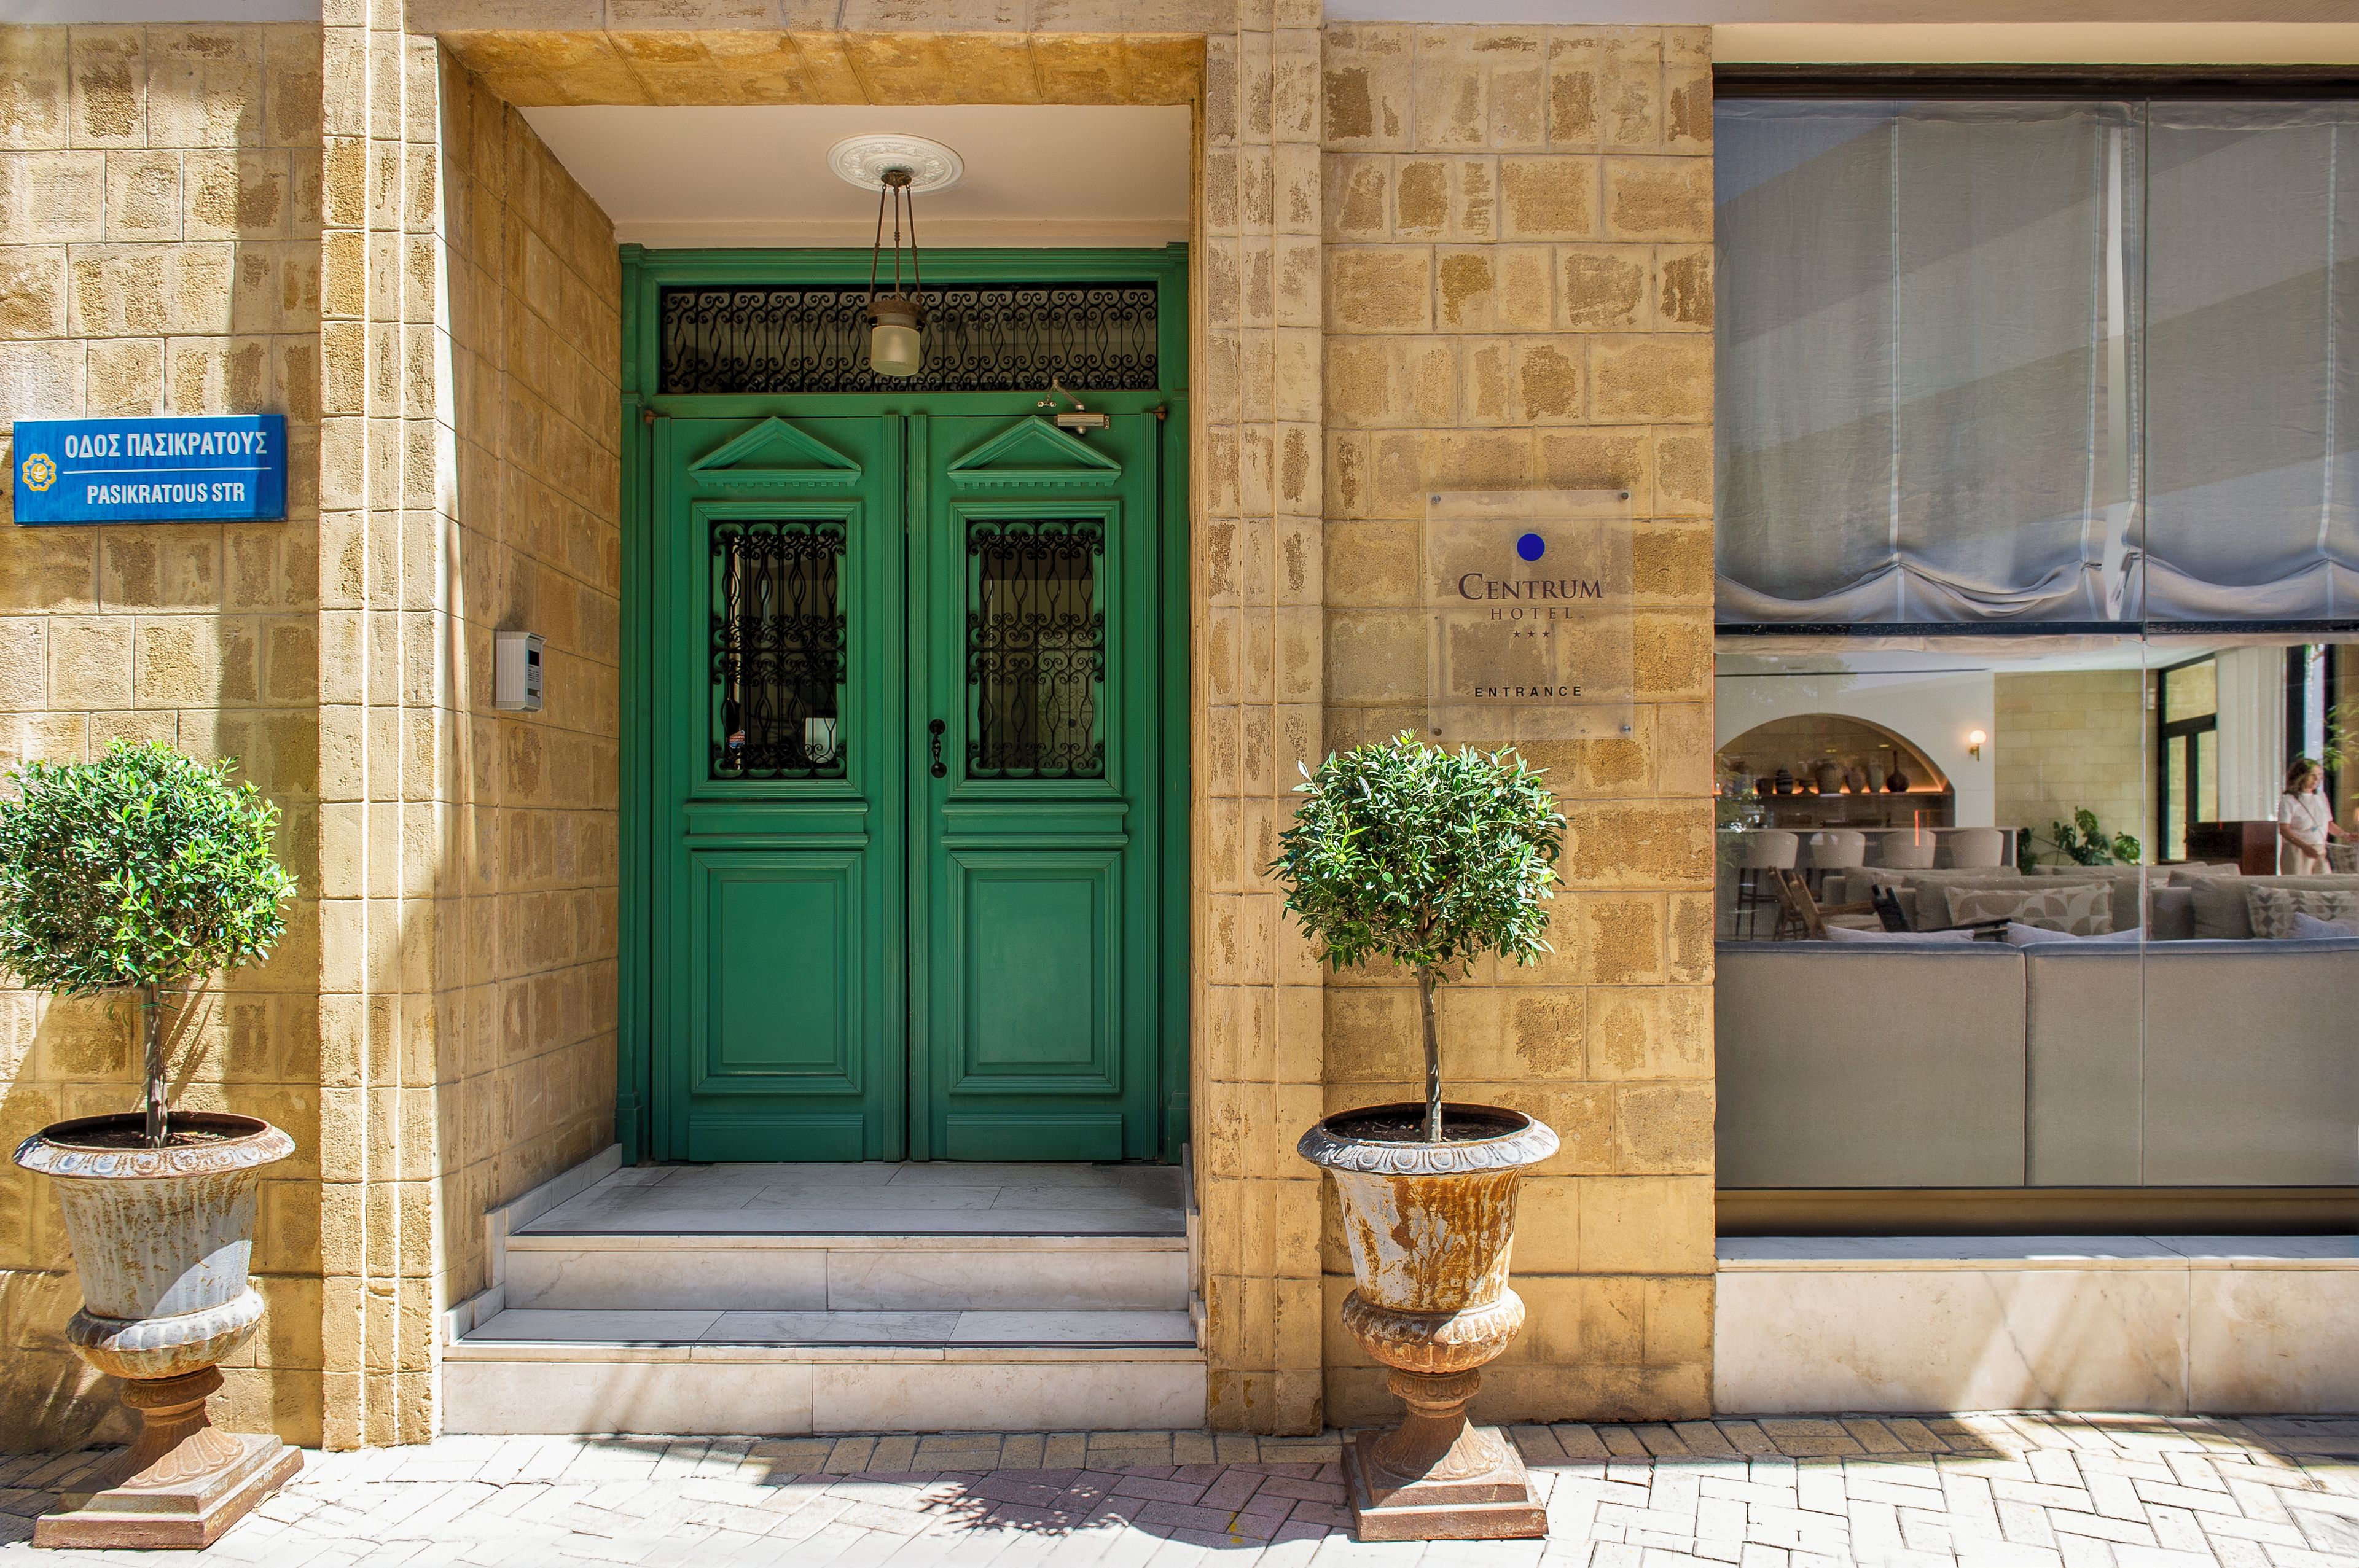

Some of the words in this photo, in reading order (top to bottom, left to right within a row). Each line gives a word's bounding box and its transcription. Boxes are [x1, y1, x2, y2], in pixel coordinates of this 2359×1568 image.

[65, 433, 120, 458] ΟΔΟΣ
[127, 431, 267, 458] ΠΑΣΙΚΡΑΤΟΥΣ
[87, 483, 208, 504] PASIKRATOUS
[212, 482, 245, 502] STR
[1458, 572, 1603, 600] CENTRUM
[1490, 607, 1573, 620] HOTEL
[1474, 685, 1582, 698] ENTRANCE
